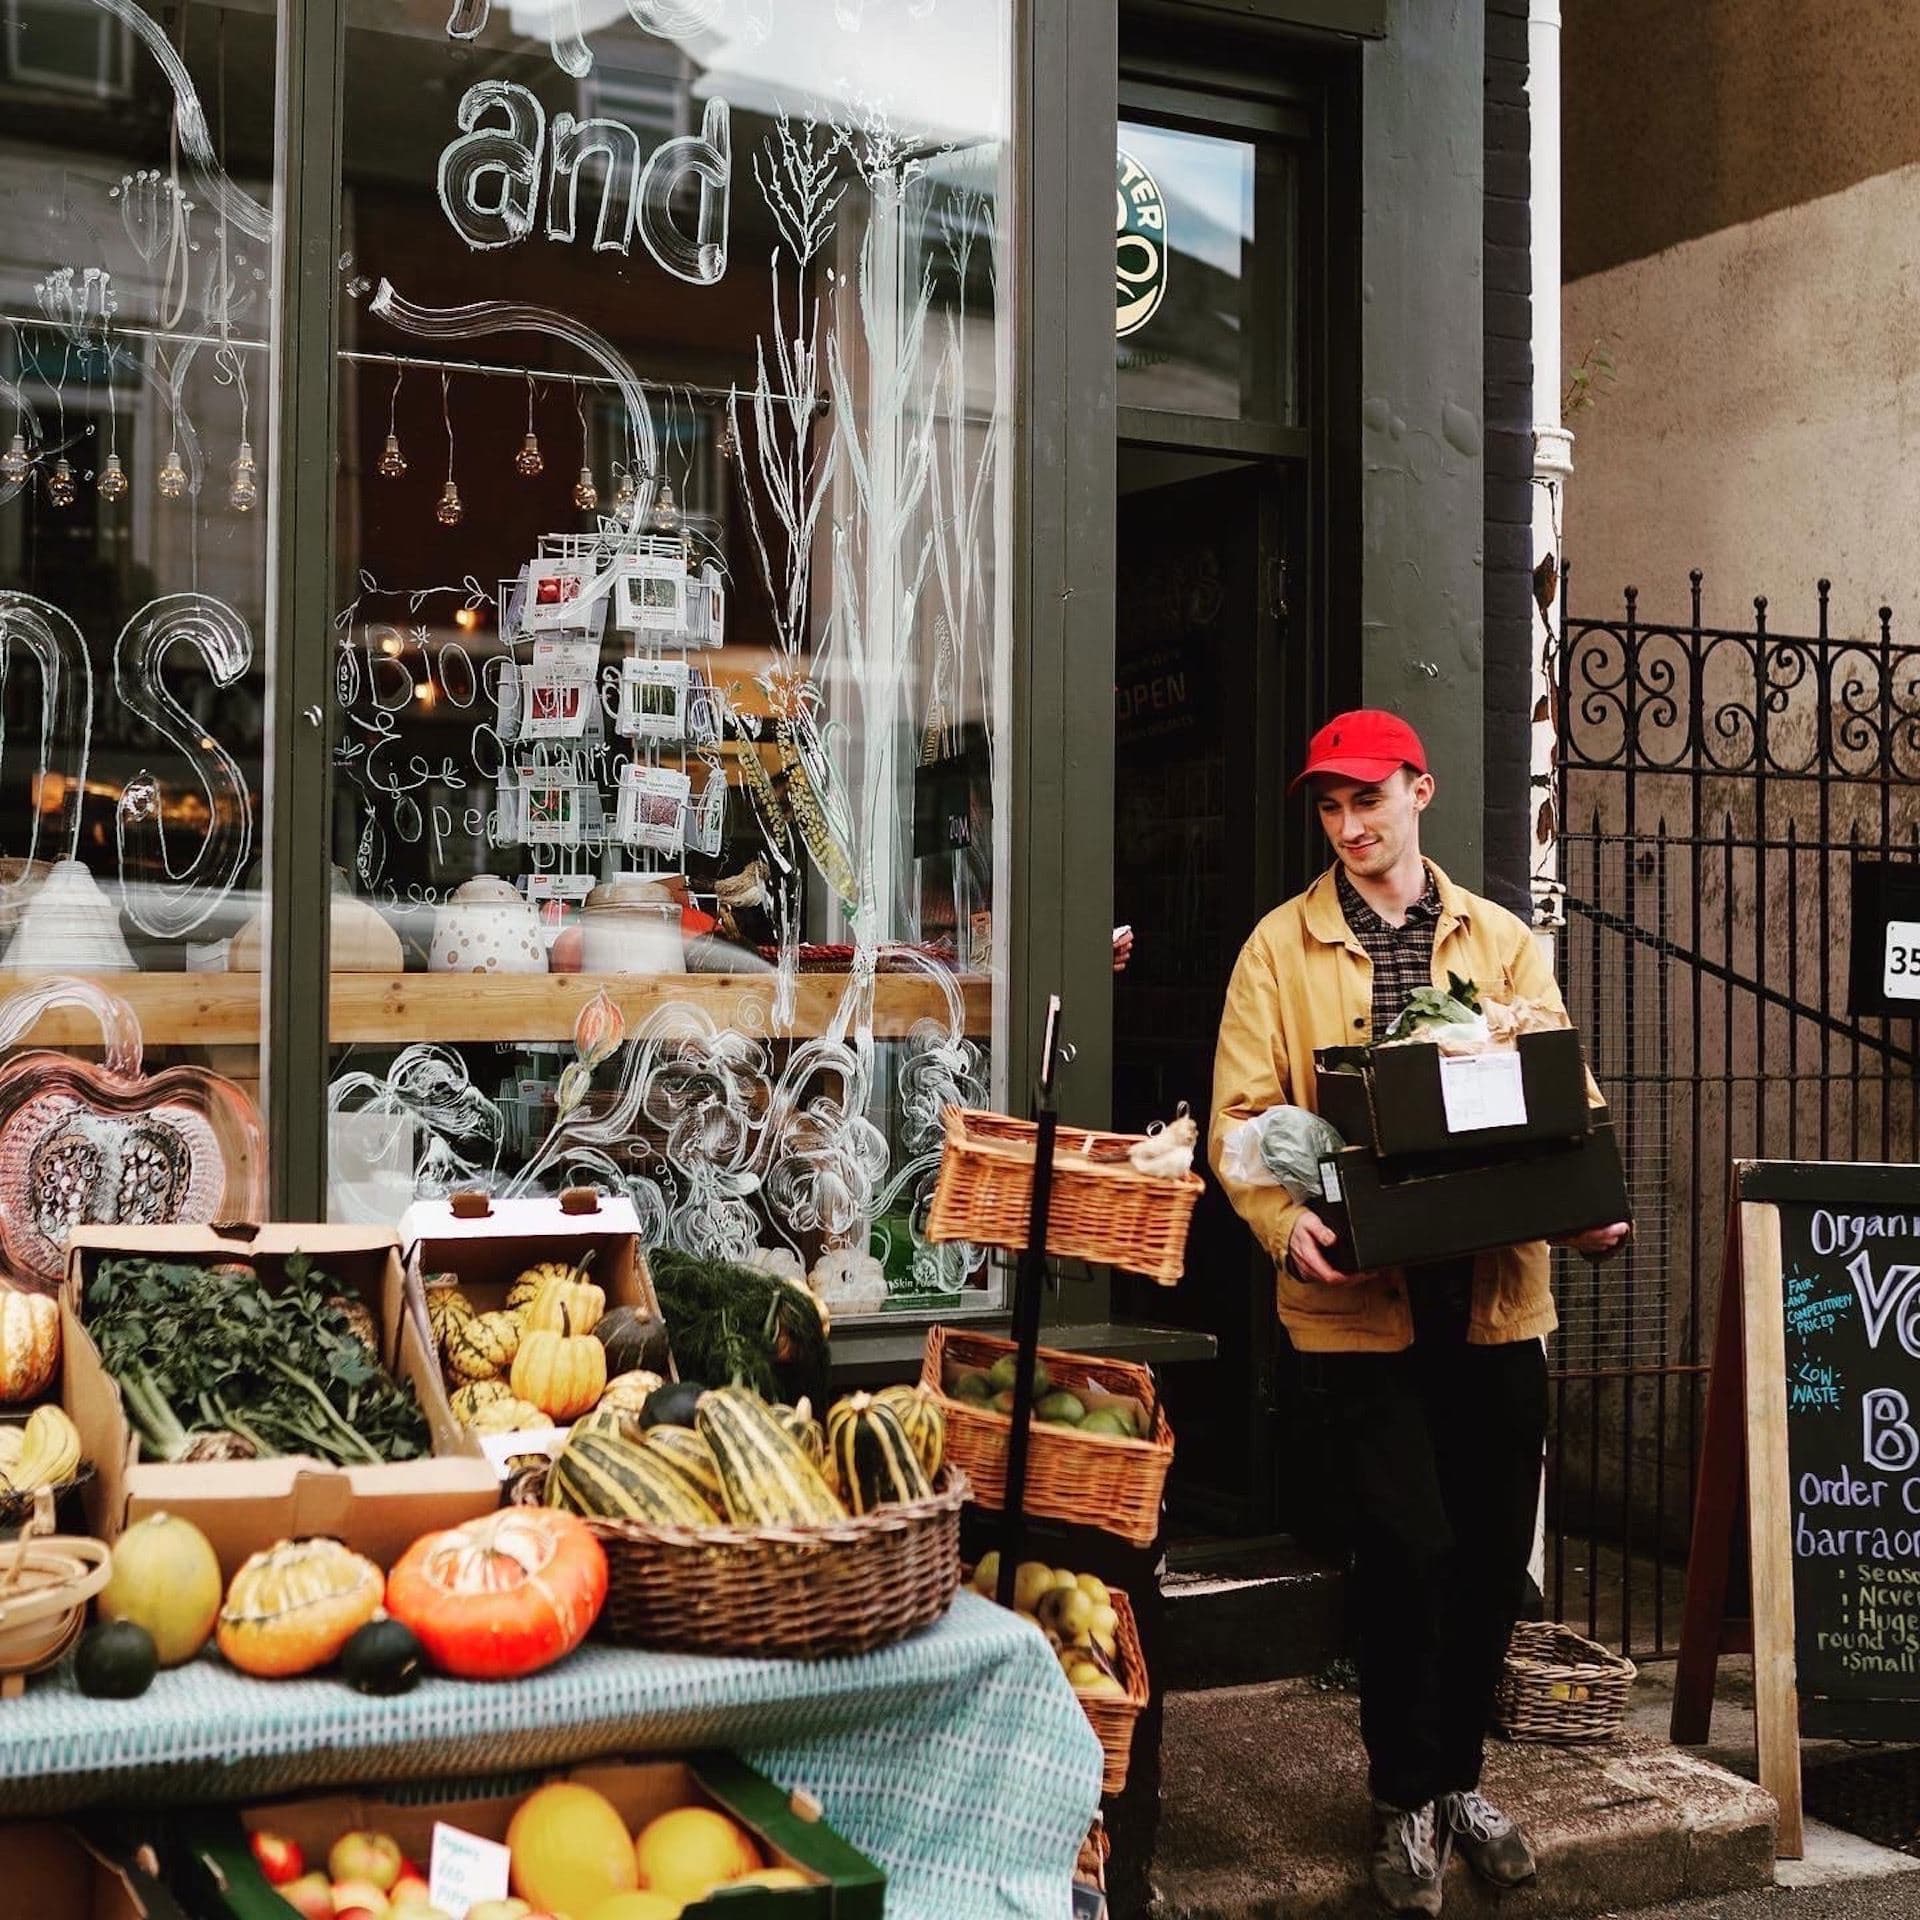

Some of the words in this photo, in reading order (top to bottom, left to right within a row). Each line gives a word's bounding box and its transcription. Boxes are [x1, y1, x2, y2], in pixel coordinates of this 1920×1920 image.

[437, 80, 731, 285] and
[1890, 946, 1920, 976] 35
[1787, 1278, 1815, 1296] FAIR
[1787, 1293, 1808, 1308] AND
[1796, 1314, 1836, 1335] PRICED
[1799, 1362, 1832, 1387] LOW
[1792, 1385, 1840, 1405] WASTE
[1862, 1388, 1920, 1472] B
[1799, 1464, 1889, 1508] Order
[1859, 1608, 1920, 1645] Huge
[1817, 1630, 1885, 1651] round
